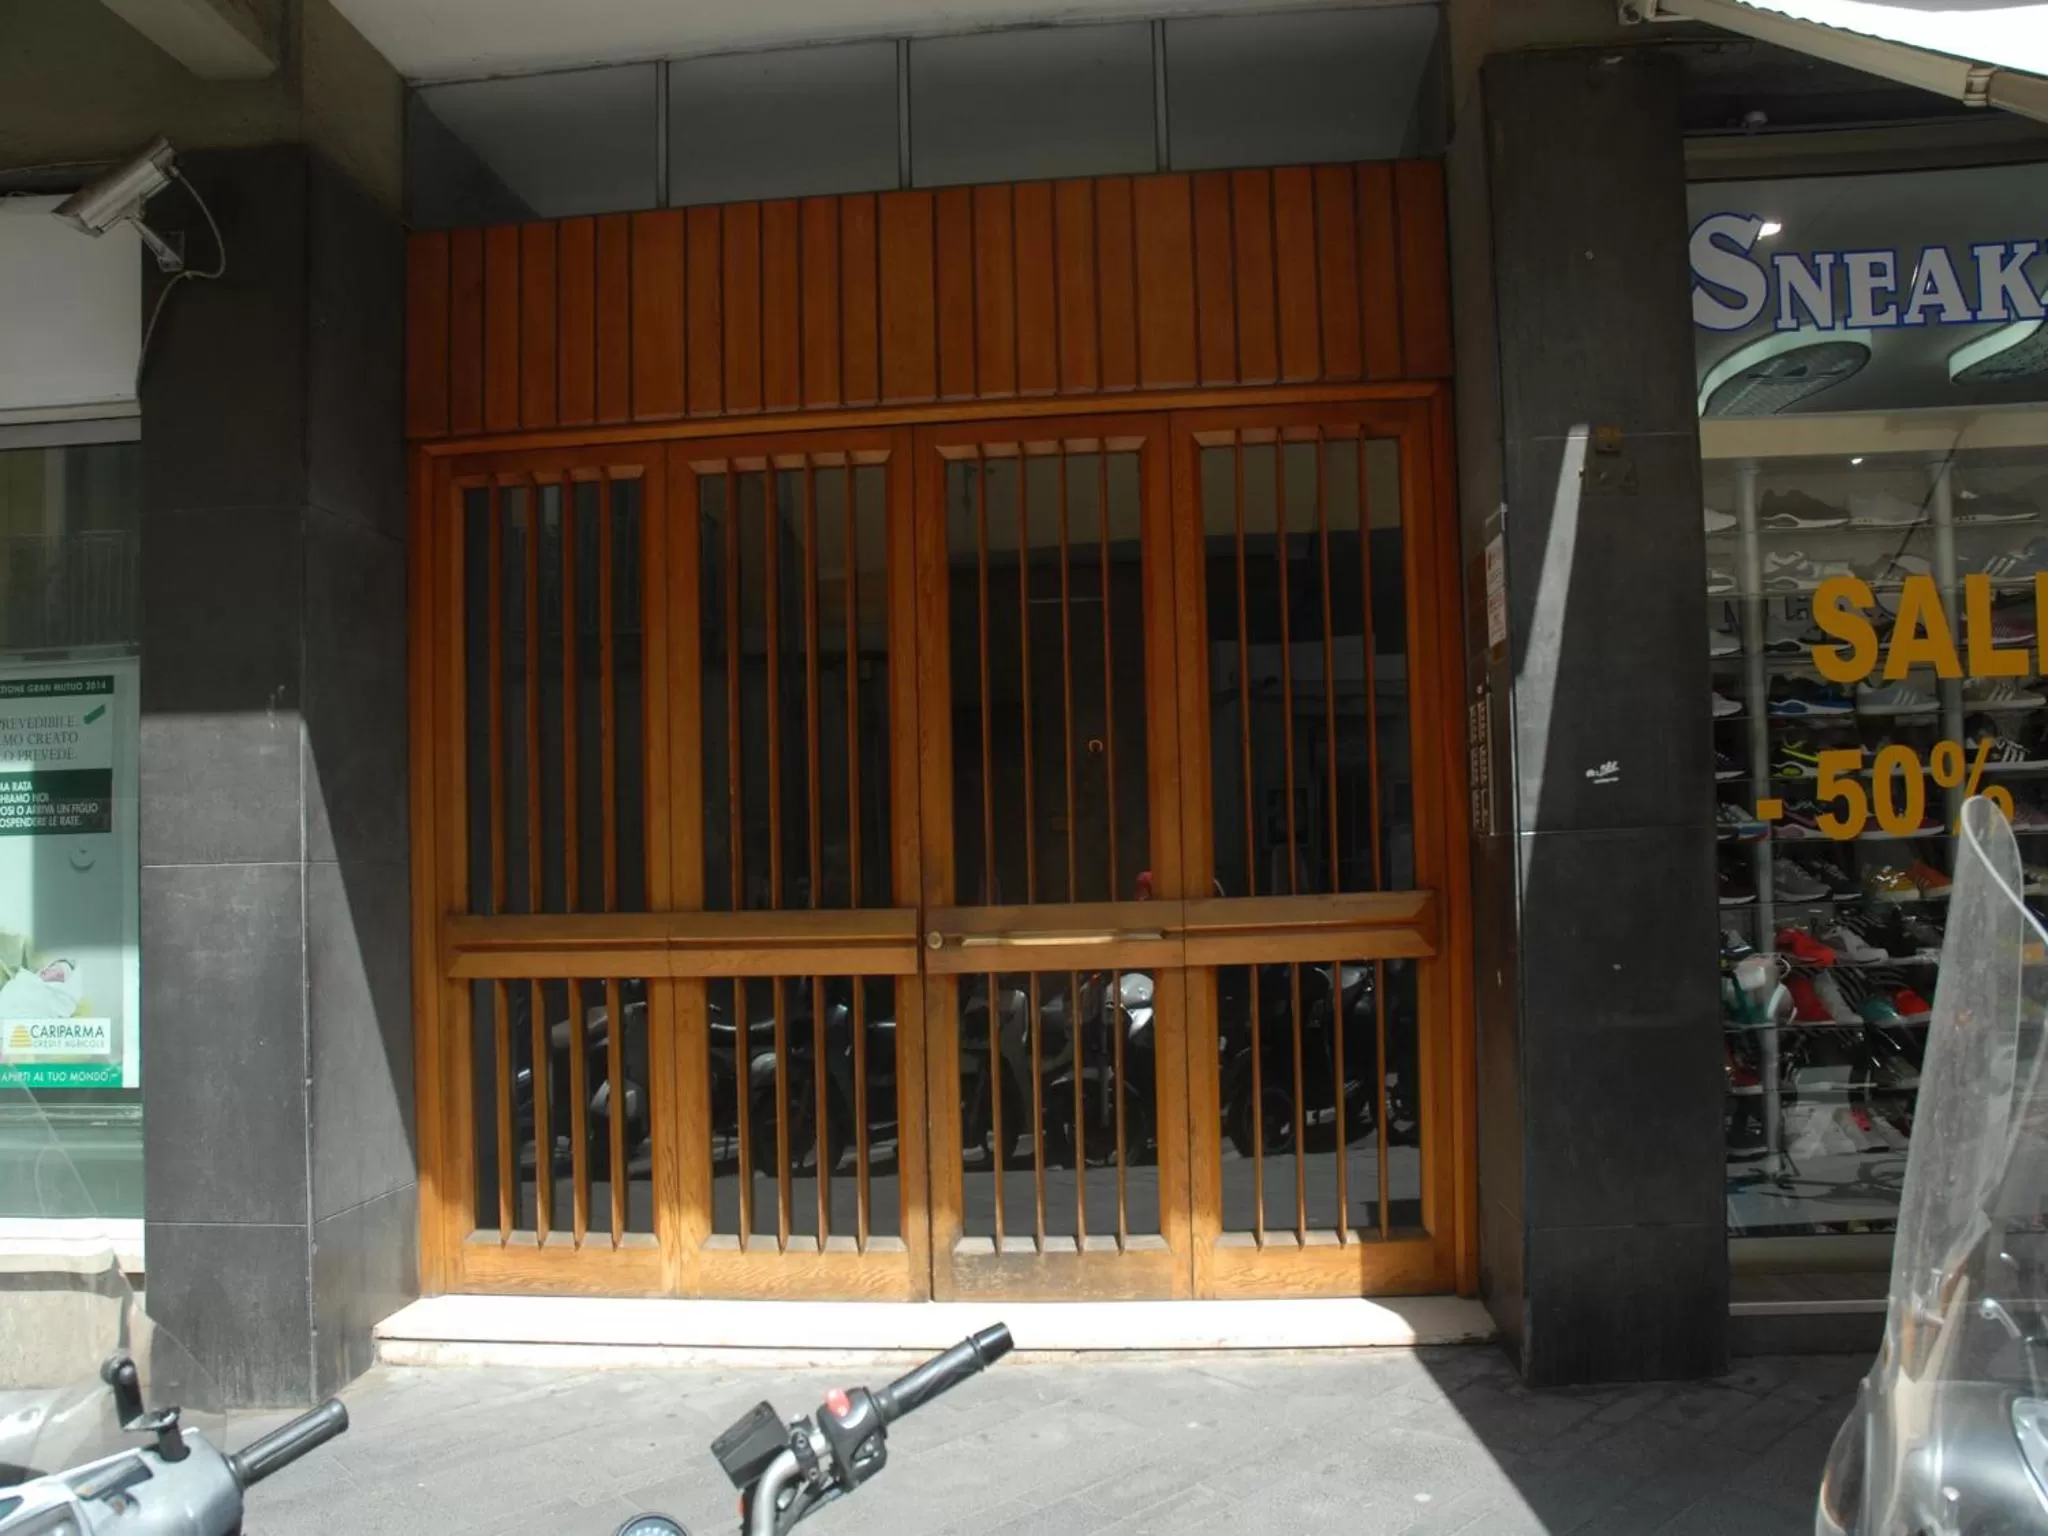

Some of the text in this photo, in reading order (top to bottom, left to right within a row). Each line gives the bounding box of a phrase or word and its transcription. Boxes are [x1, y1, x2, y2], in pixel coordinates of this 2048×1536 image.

[1689, 211, 2048, 331] SNEAK
[1811, 572, 2048, 683] SAL
[27, 731, 79, 745] CREATO
[30, 1024, 105, 1039] CARIPARMA
[33, 1071, 45, 1082] AL
[47, 1071, 67, 1082] TUO
